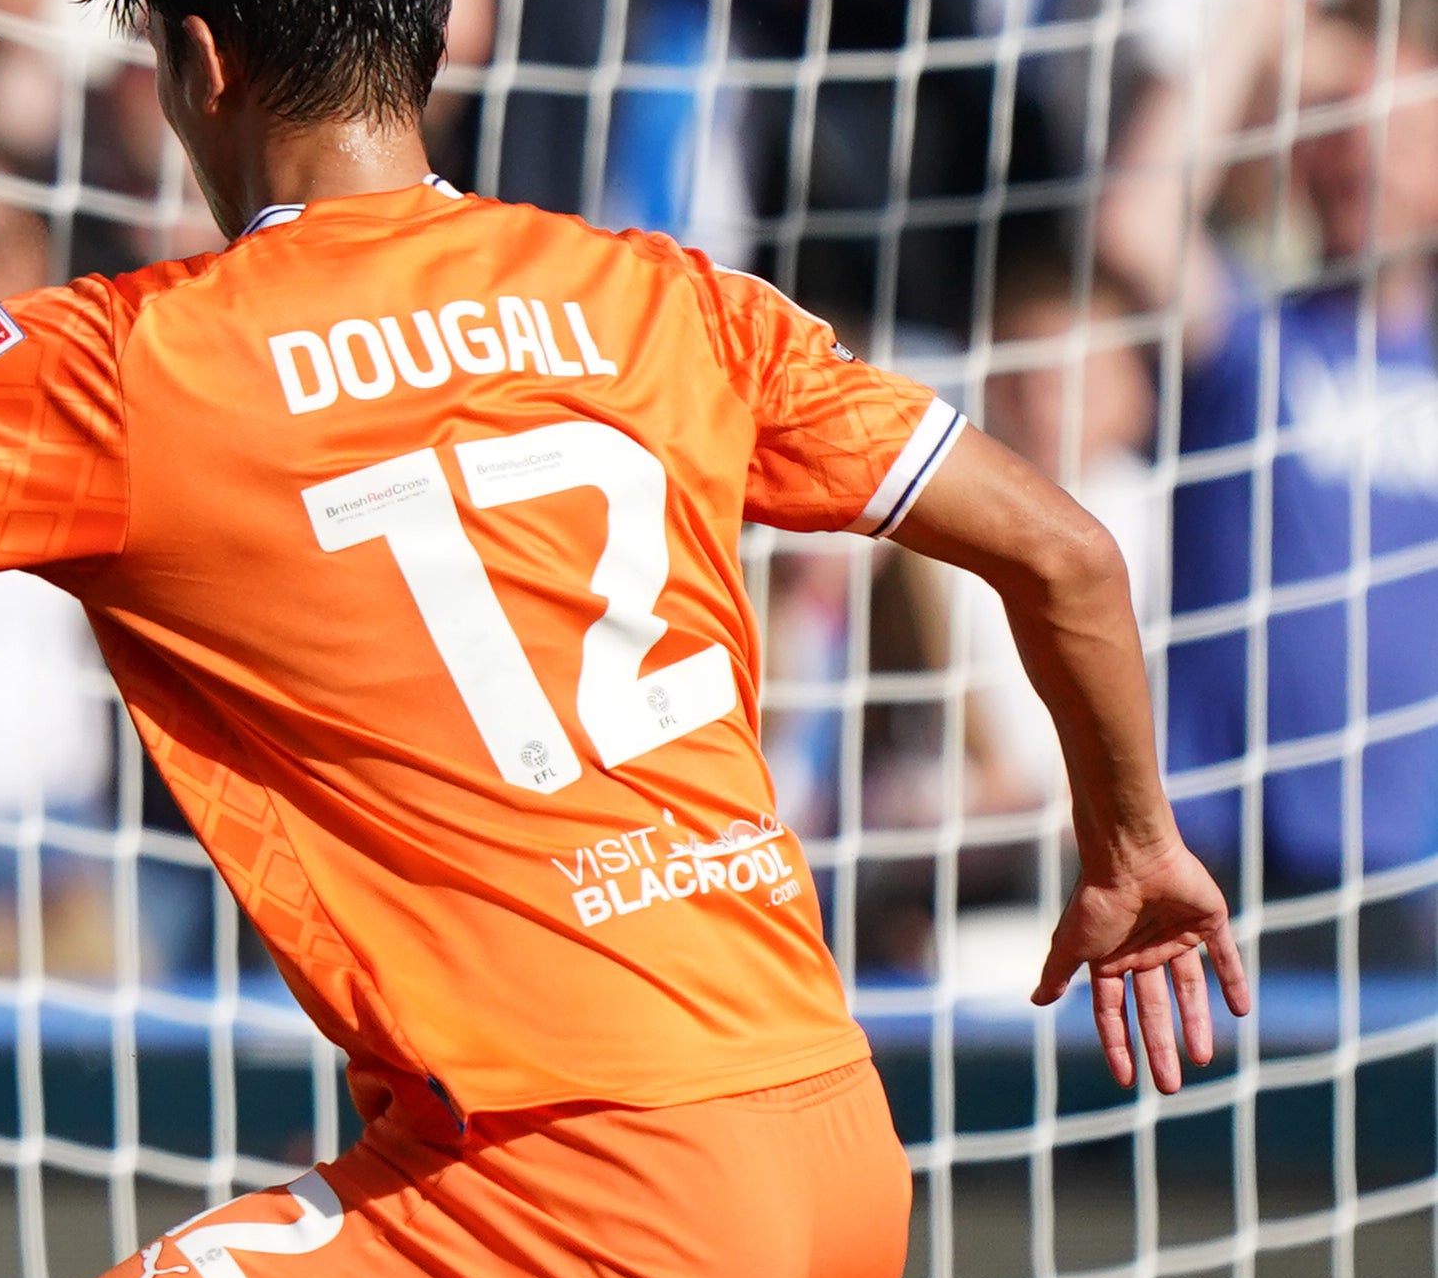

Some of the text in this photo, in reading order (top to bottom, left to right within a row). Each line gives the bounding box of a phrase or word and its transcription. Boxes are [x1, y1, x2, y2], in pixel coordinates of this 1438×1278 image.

[269, 295, 617, 414] DOUGALL
[325, 476, 430, 519] BritishRedCross
[302, 421, 736, 794] 12
[534, 767, 557, 785] EFL
[550, 826, 658, 887] VISIT
